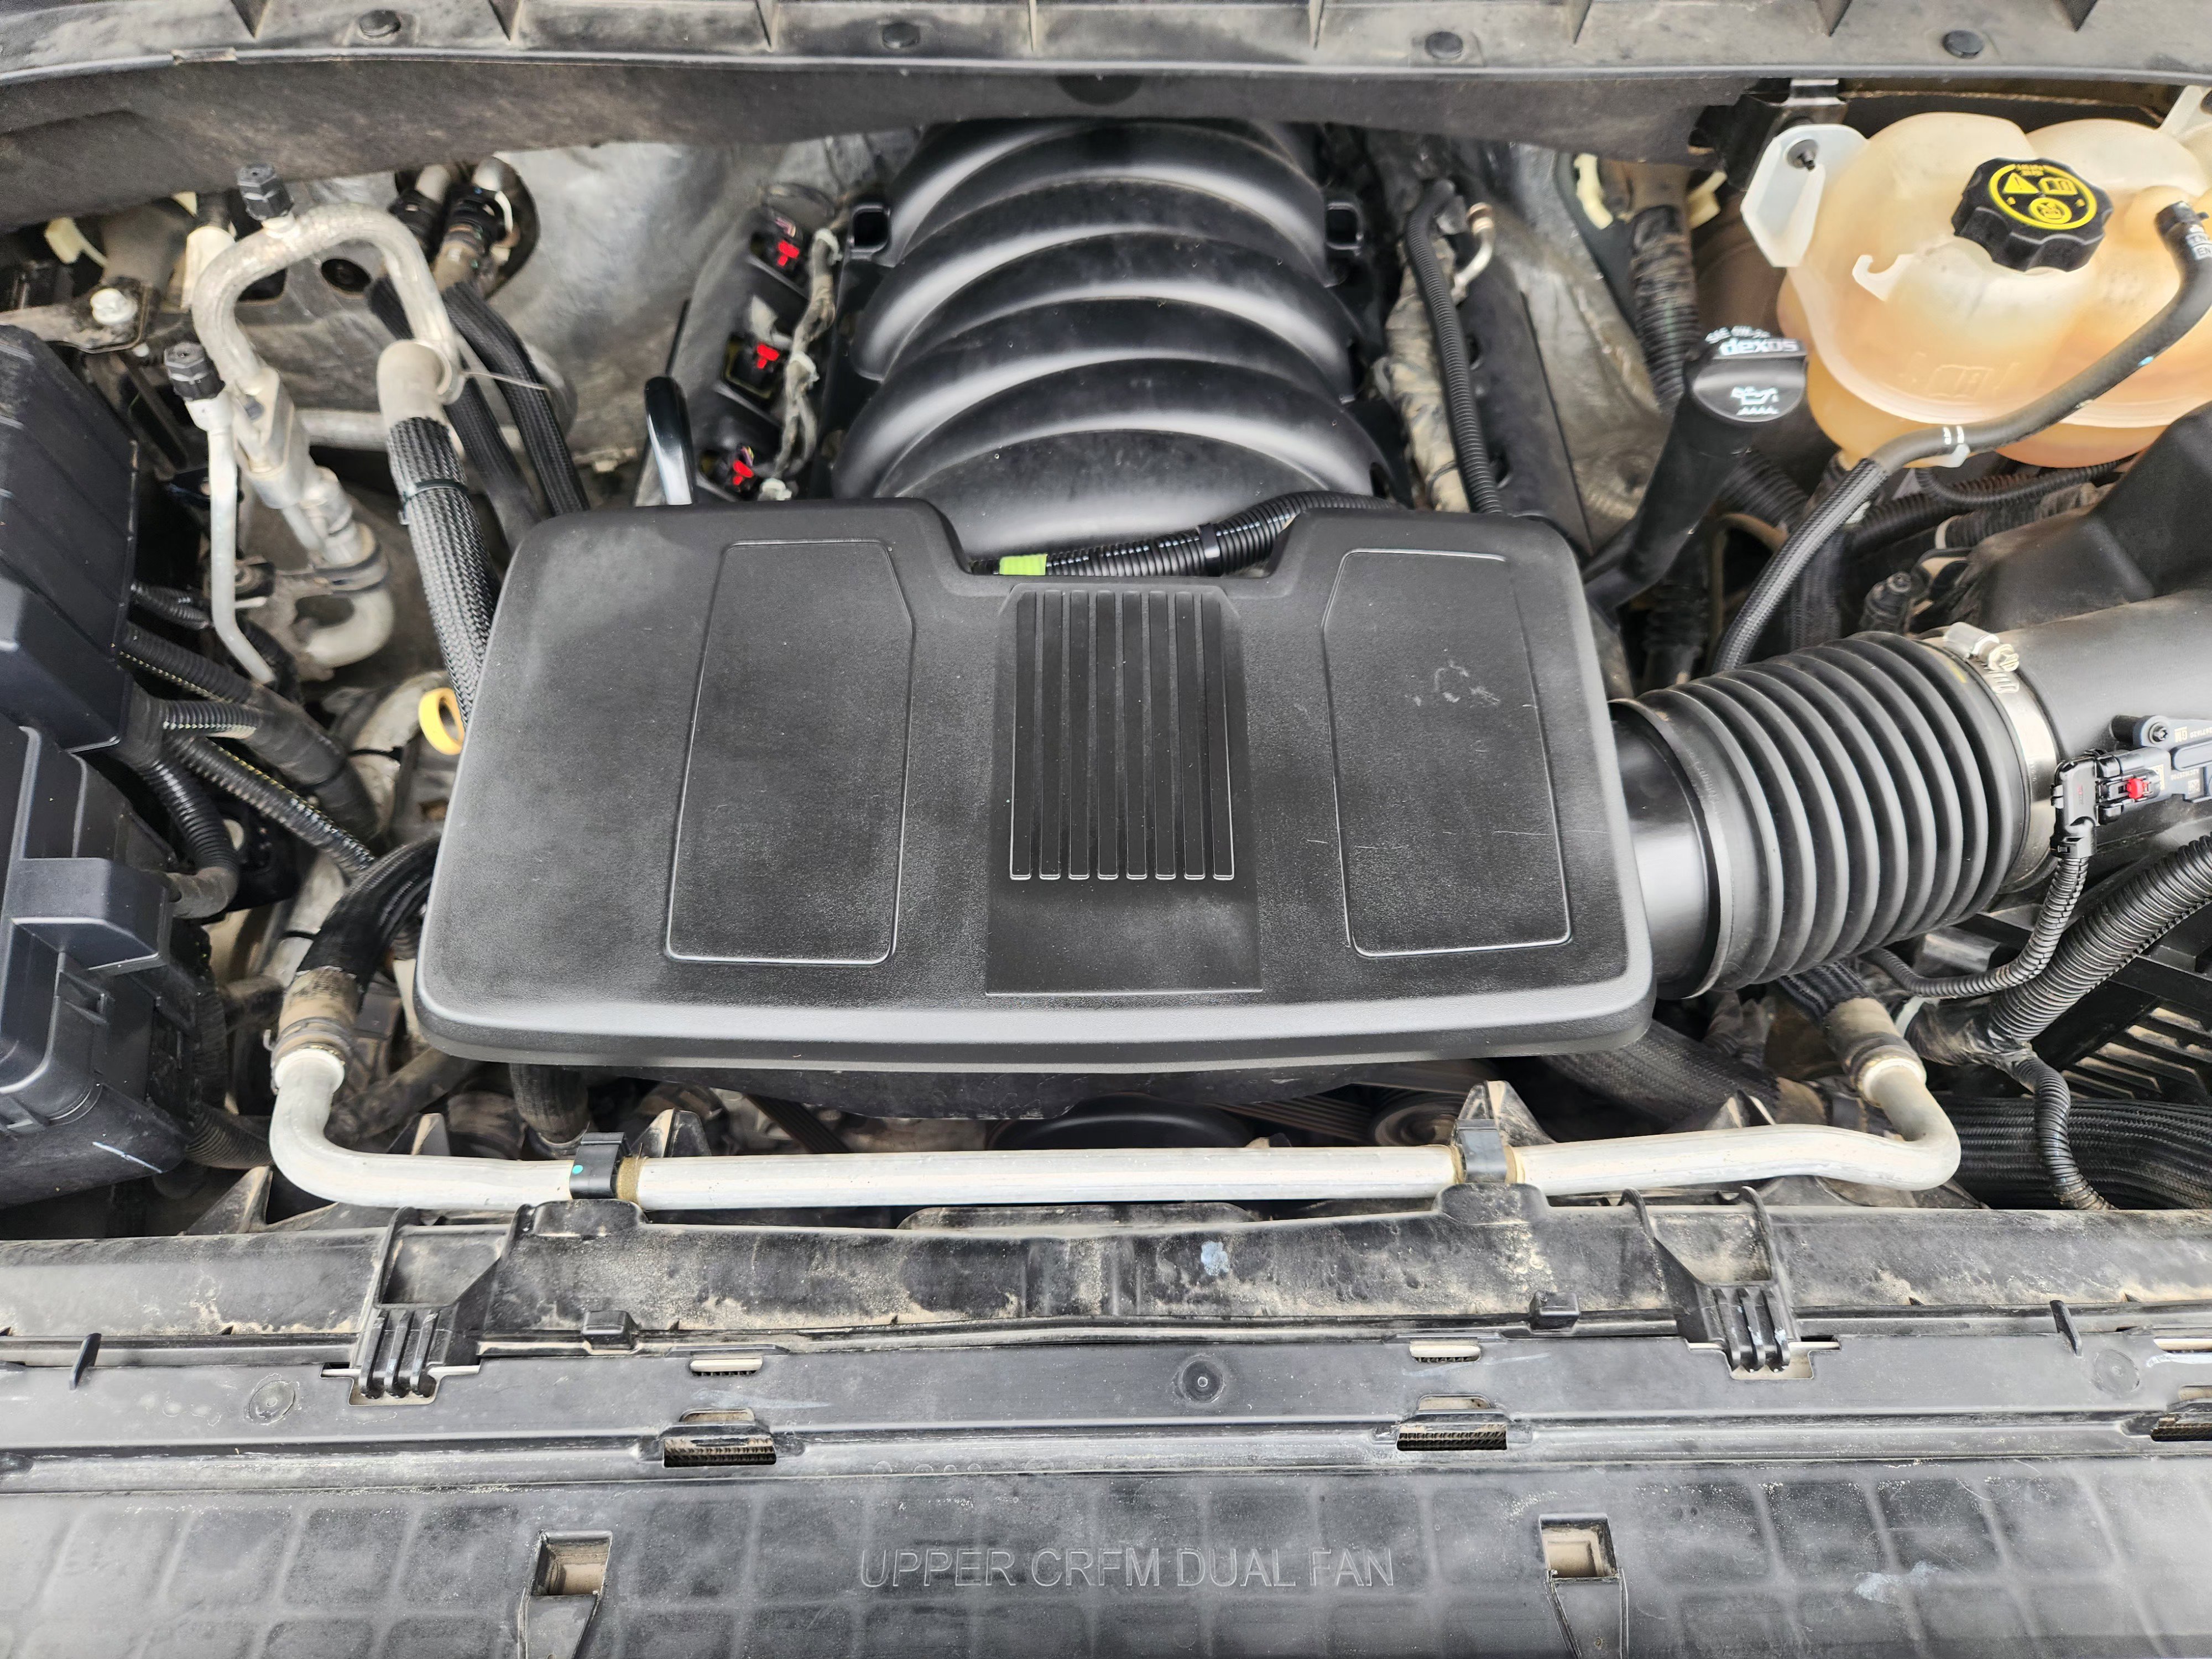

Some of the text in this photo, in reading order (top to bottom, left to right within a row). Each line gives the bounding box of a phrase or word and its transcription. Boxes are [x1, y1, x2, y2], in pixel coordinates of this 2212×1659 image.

[1718, 337, 1800, 356] dexos
[2174, 727, 2188, 743] GM
[860, 1547, 1394, 1587] UPPER CRFM DUAL FAN
